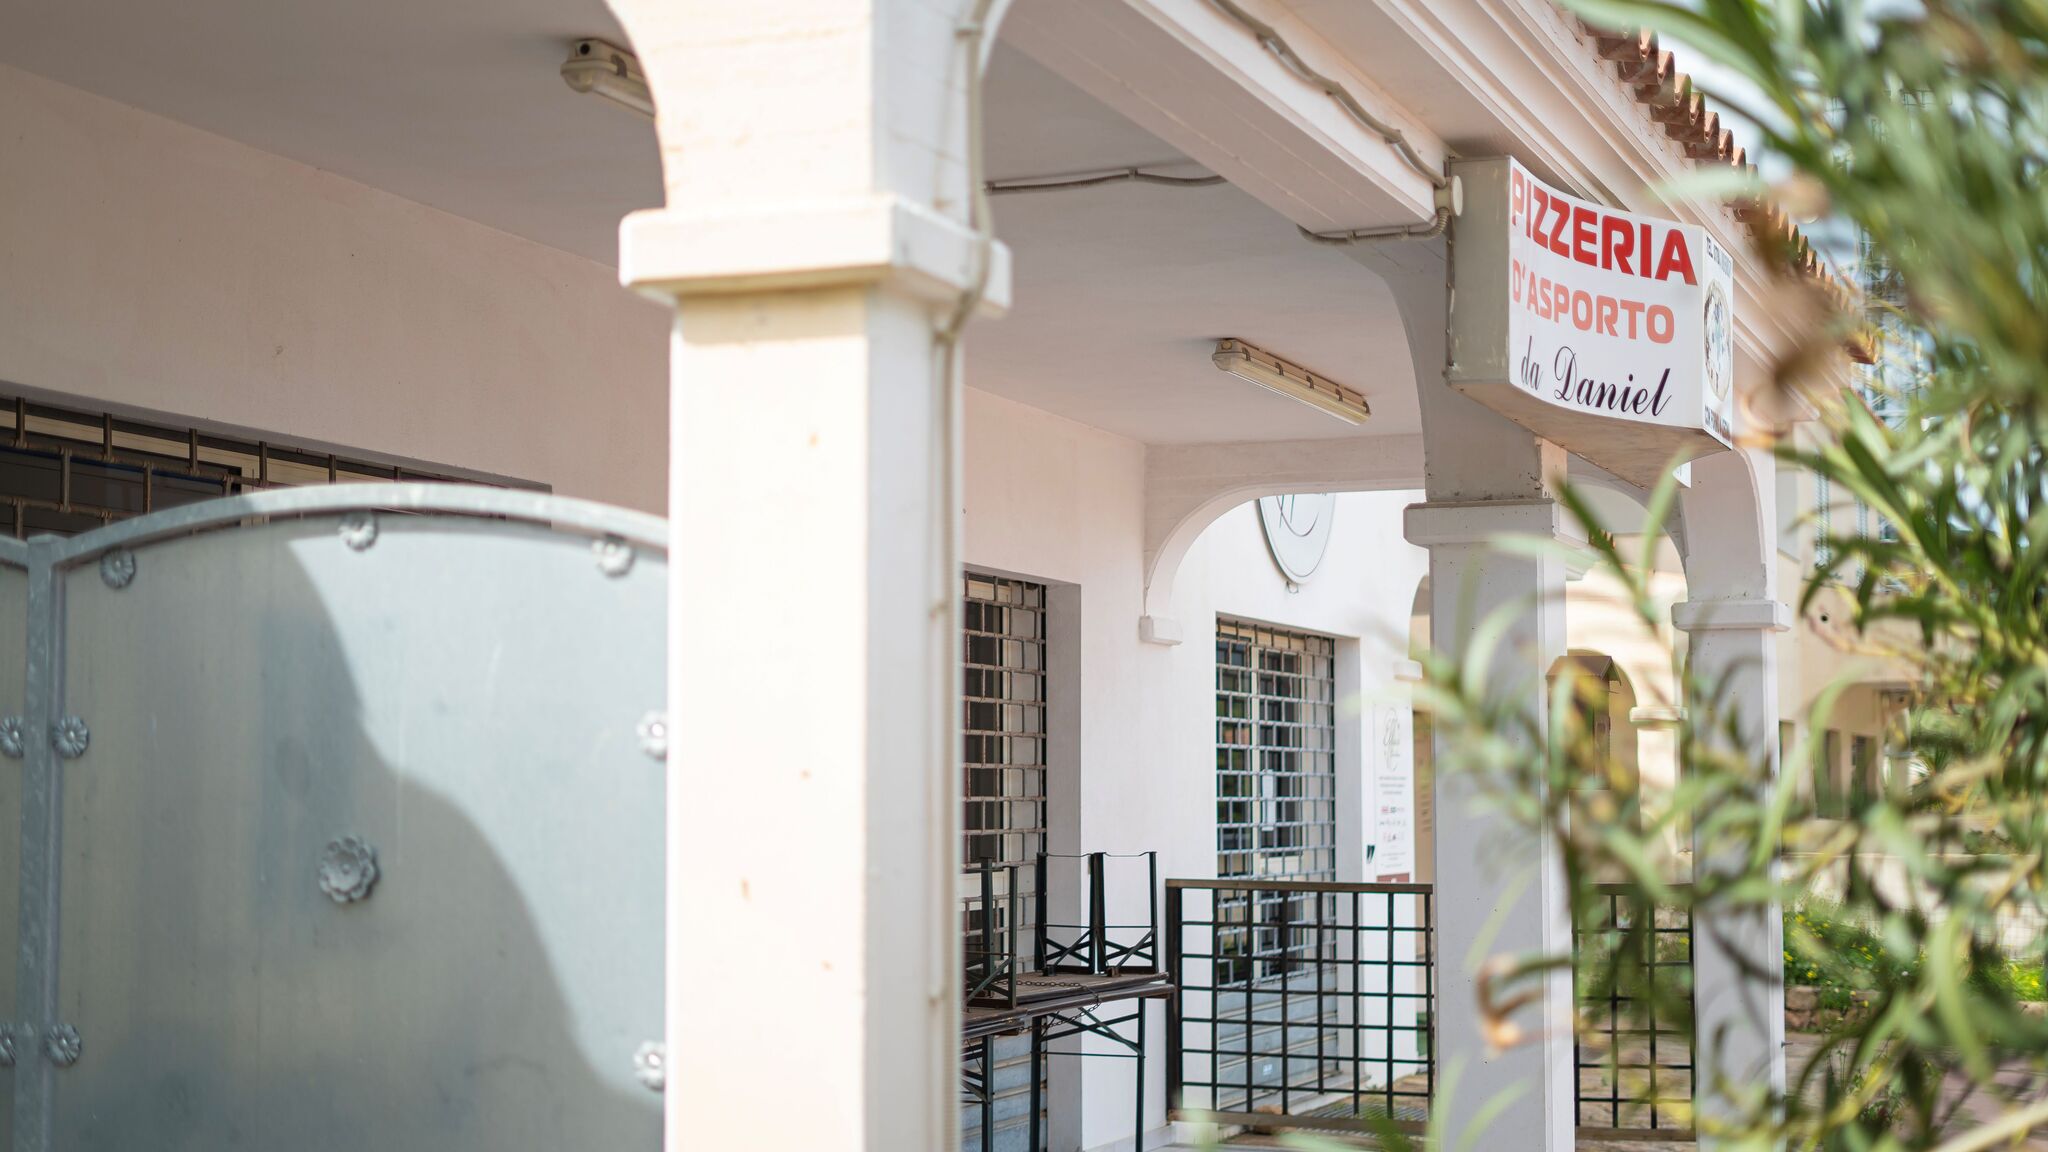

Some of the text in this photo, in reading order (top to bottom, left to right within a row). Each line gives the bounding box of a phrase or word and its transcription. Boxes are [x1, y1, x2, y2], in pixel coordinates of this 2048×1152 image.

[1511, 167, 1698, 286] PIZZERIA
[1512, 258, 1675, 344] D'ASPORTO
[1521, 335, 1672, 416] da Daniel
